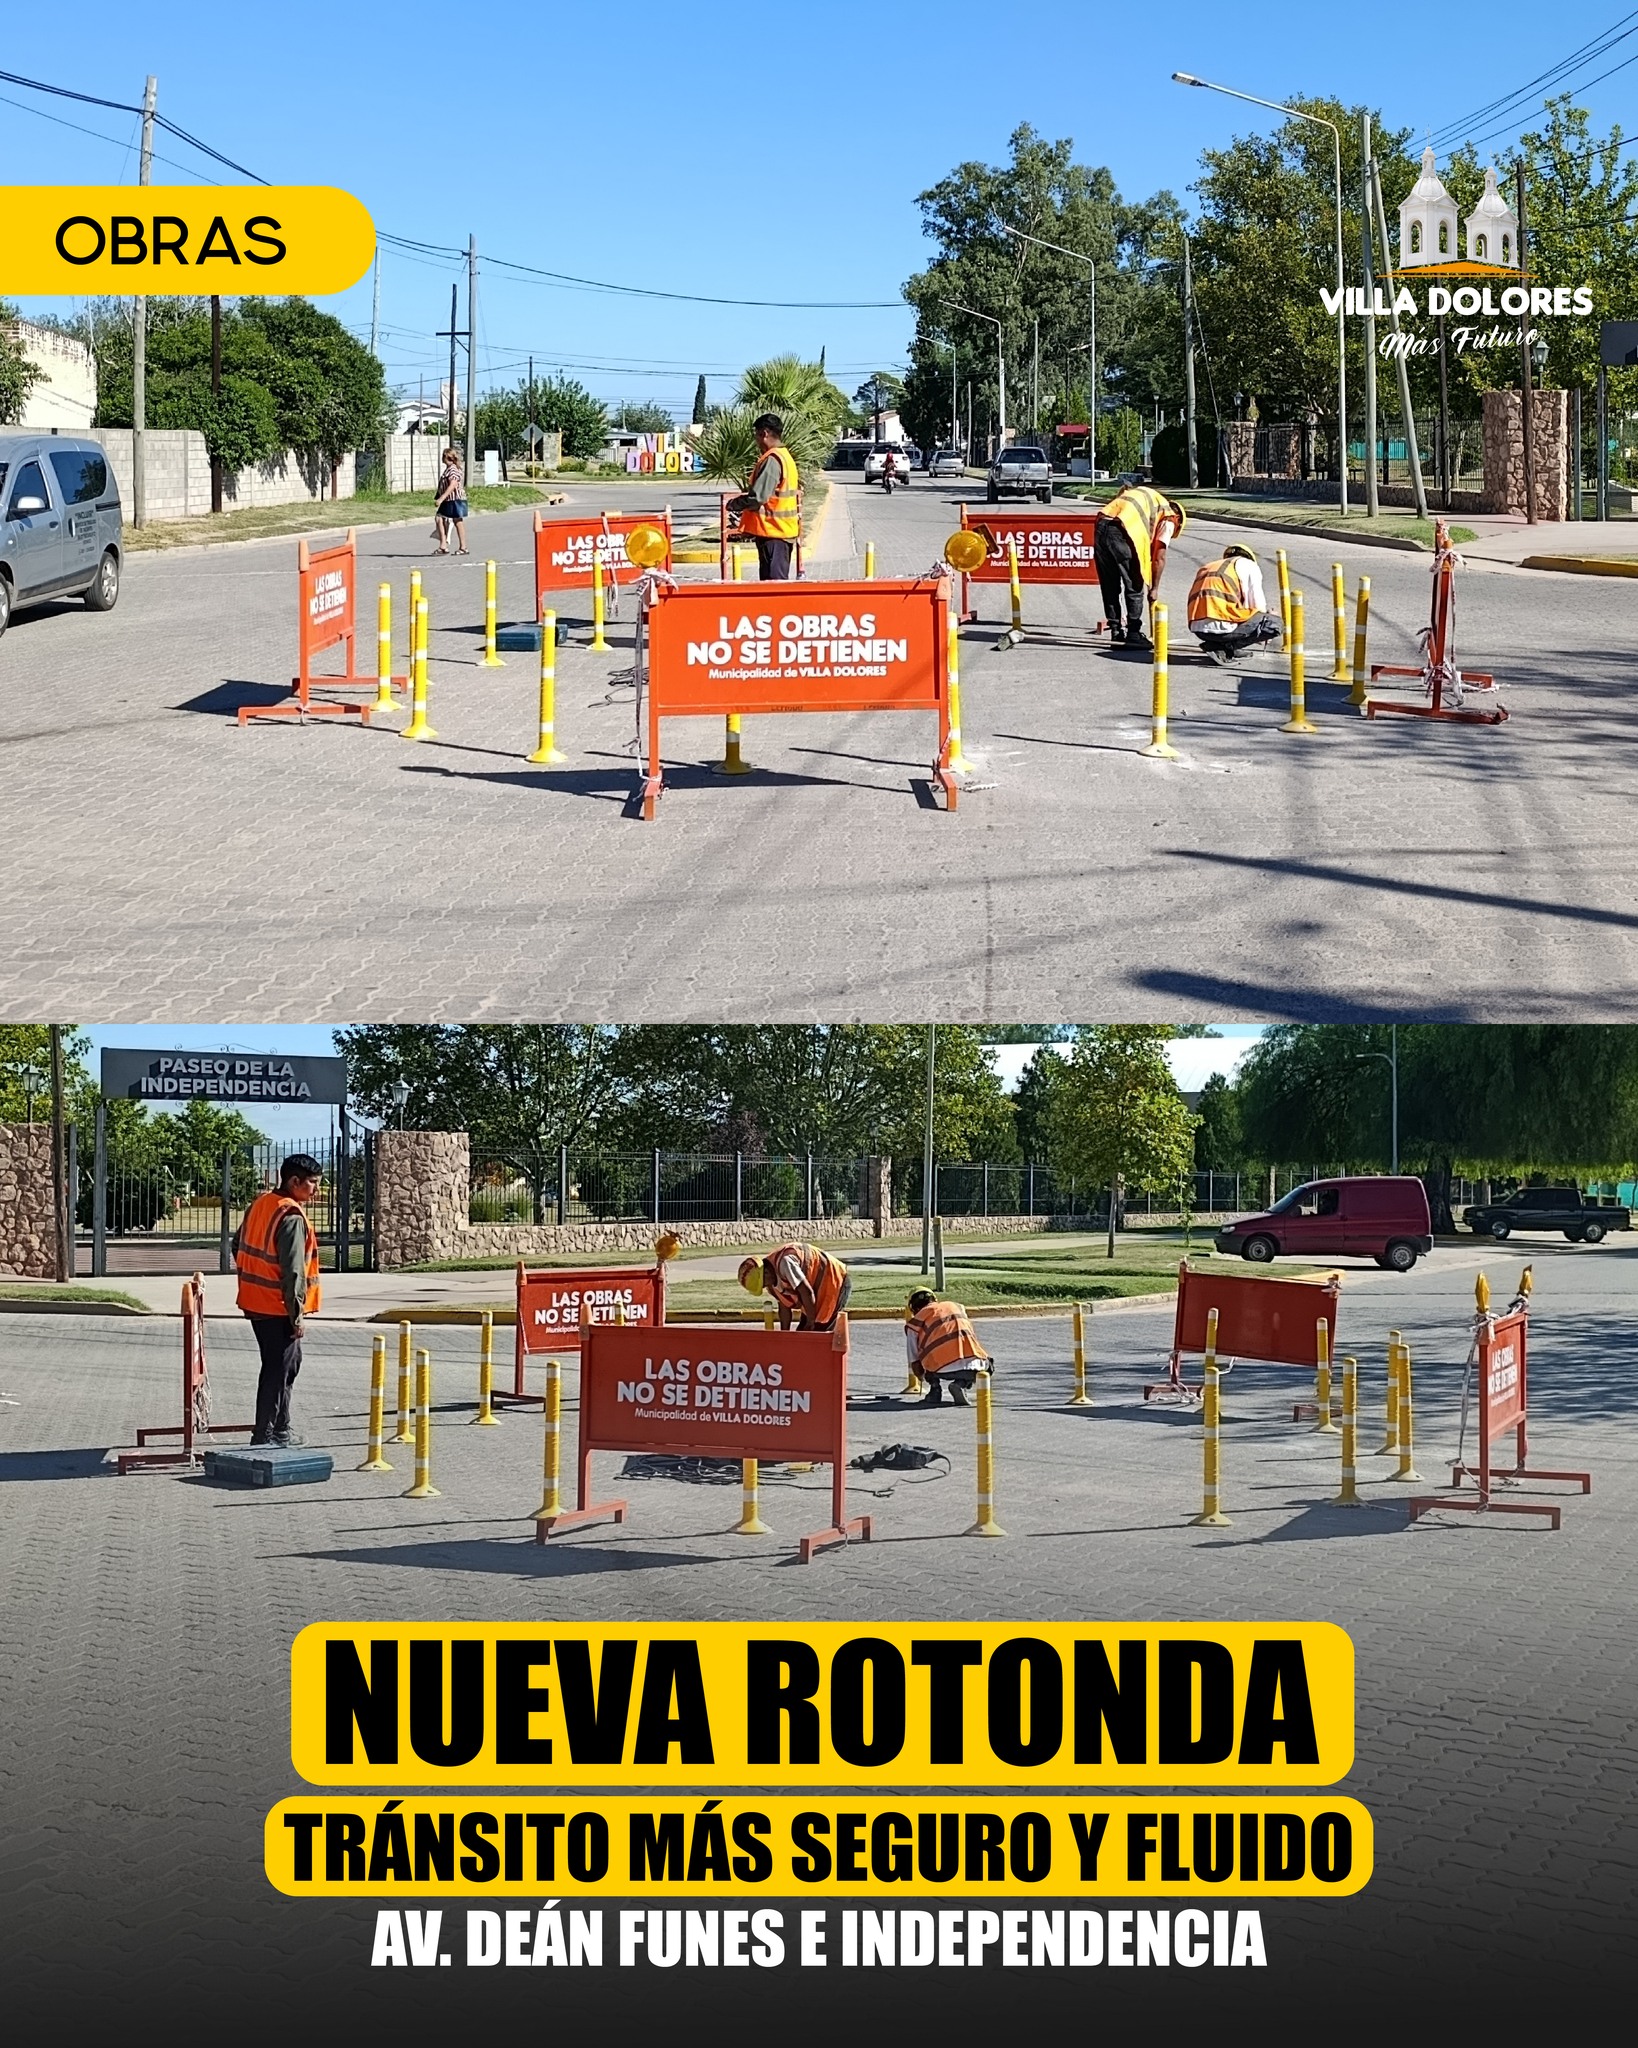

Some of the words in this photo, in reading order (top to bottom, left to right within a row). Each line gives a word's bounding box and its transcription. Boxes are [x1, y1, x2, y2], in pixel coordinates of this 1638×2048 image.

[626, 452, 707, 473] DOLORE
[567, 535, 594, 550] LAS
[596, 533, 630, 549] OBR
[995, 531, 1025, 545] LAS
[1028, 531, 1083, 545] OBRAS
[552, 551, 575, 566] NO
[578, 550, 594, 564] SE
[719, 615, 772, 639] LAS
[779, 614, 876, 638] OBRAS
[687, 641, 732, 665] NO
[739, 640, 771, 664] SE
[778, 639, 907, 664] DETIENEN
[708, 667, 781, 681] Municipalidad
[784, 666, 798, 678] de
[799, 666, 831, 677] VILLA
[833, 665, 887, 677] DOLORES
[159, 1057, 229, 1075] PASEO
[235, 1060, 263, 1076] DE
[268, 1061, 295, 1077] LA
[141, 1076, 311, 1097] INDEPENDENCIA
[552, 1291, 580, 1307] LAS
[583, 1289, 632, 1305] OBRAS
[535, 1308, 558, 1324] NO
[562, 1307, 579, 1323] SE
[645, 1358, 690, 1381] LAS
[696, 1360, 783, 1386] OBRAS
[617, 1381, 655, 1404] NO
[661, 1383, 688, 1406] SE
[695, 1385, 811, 1413] DETIENEN
[634, 1407, 697, 1421] Municipalidad
[699, 1411, 711, 1422] de
[712, 1412, 741, 1424] VILLA
[743, 1413, 791, 1426] DOLORES
